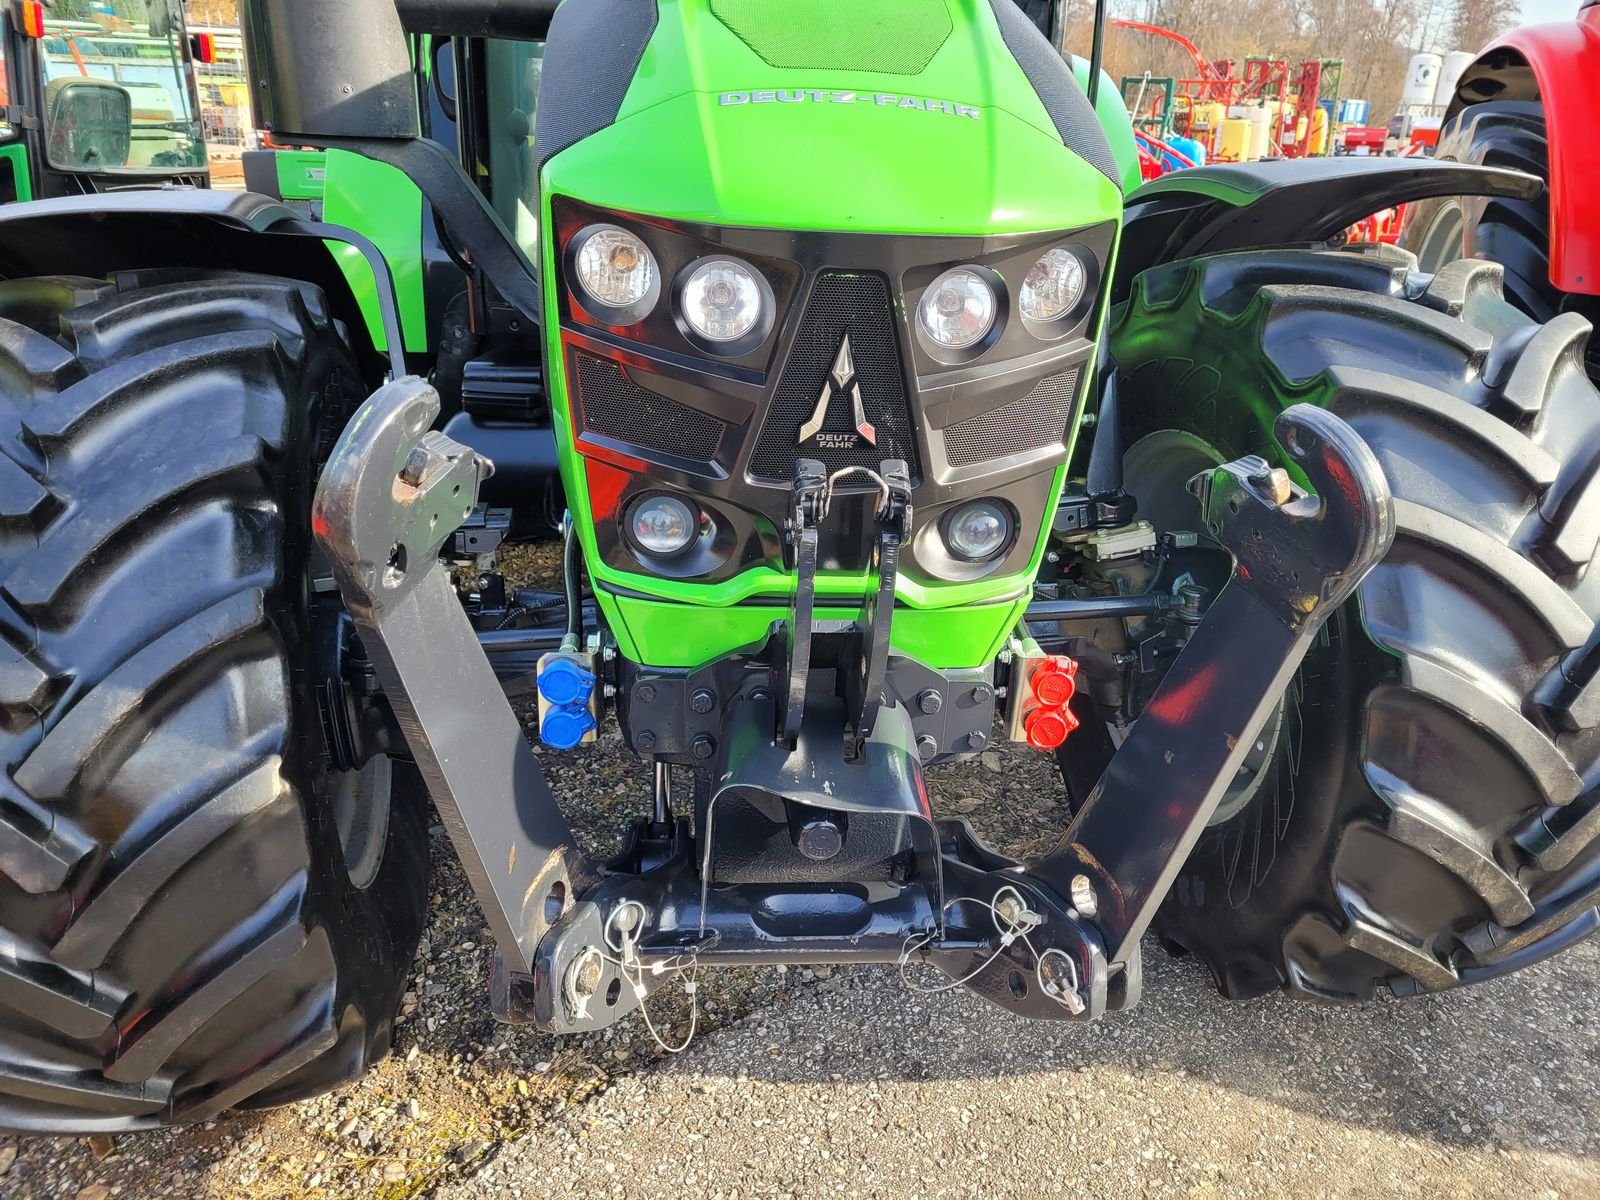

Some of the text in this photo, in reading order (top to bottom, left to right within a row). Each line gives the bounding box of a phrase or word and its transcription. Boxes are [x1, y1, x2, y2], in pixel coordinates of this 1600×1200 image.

[718, 89, 980, 120] DEUTZ-FAHR
[816, 433, 858, 442] DEUTZ
[820, 441, 854, 449] FAHR
